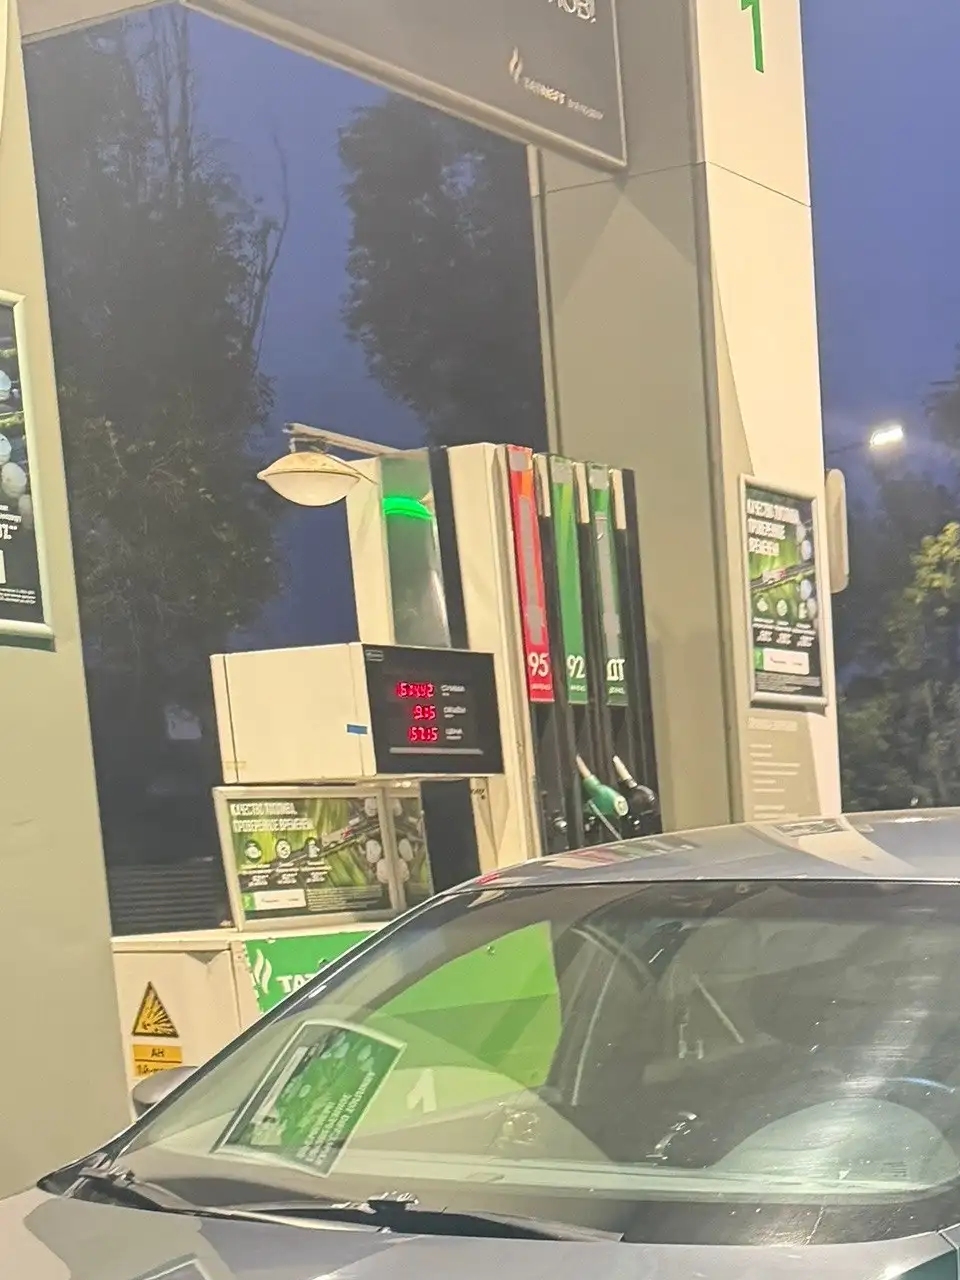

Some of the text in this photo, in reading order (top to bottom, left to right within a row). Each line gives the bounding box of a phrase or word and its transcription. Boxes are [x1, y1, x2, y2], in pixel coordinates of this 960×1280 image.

[527, 651, 550, 677] 95
[566, 654, 586, 679] 92
[606, 658, 626, 681] ДТ
